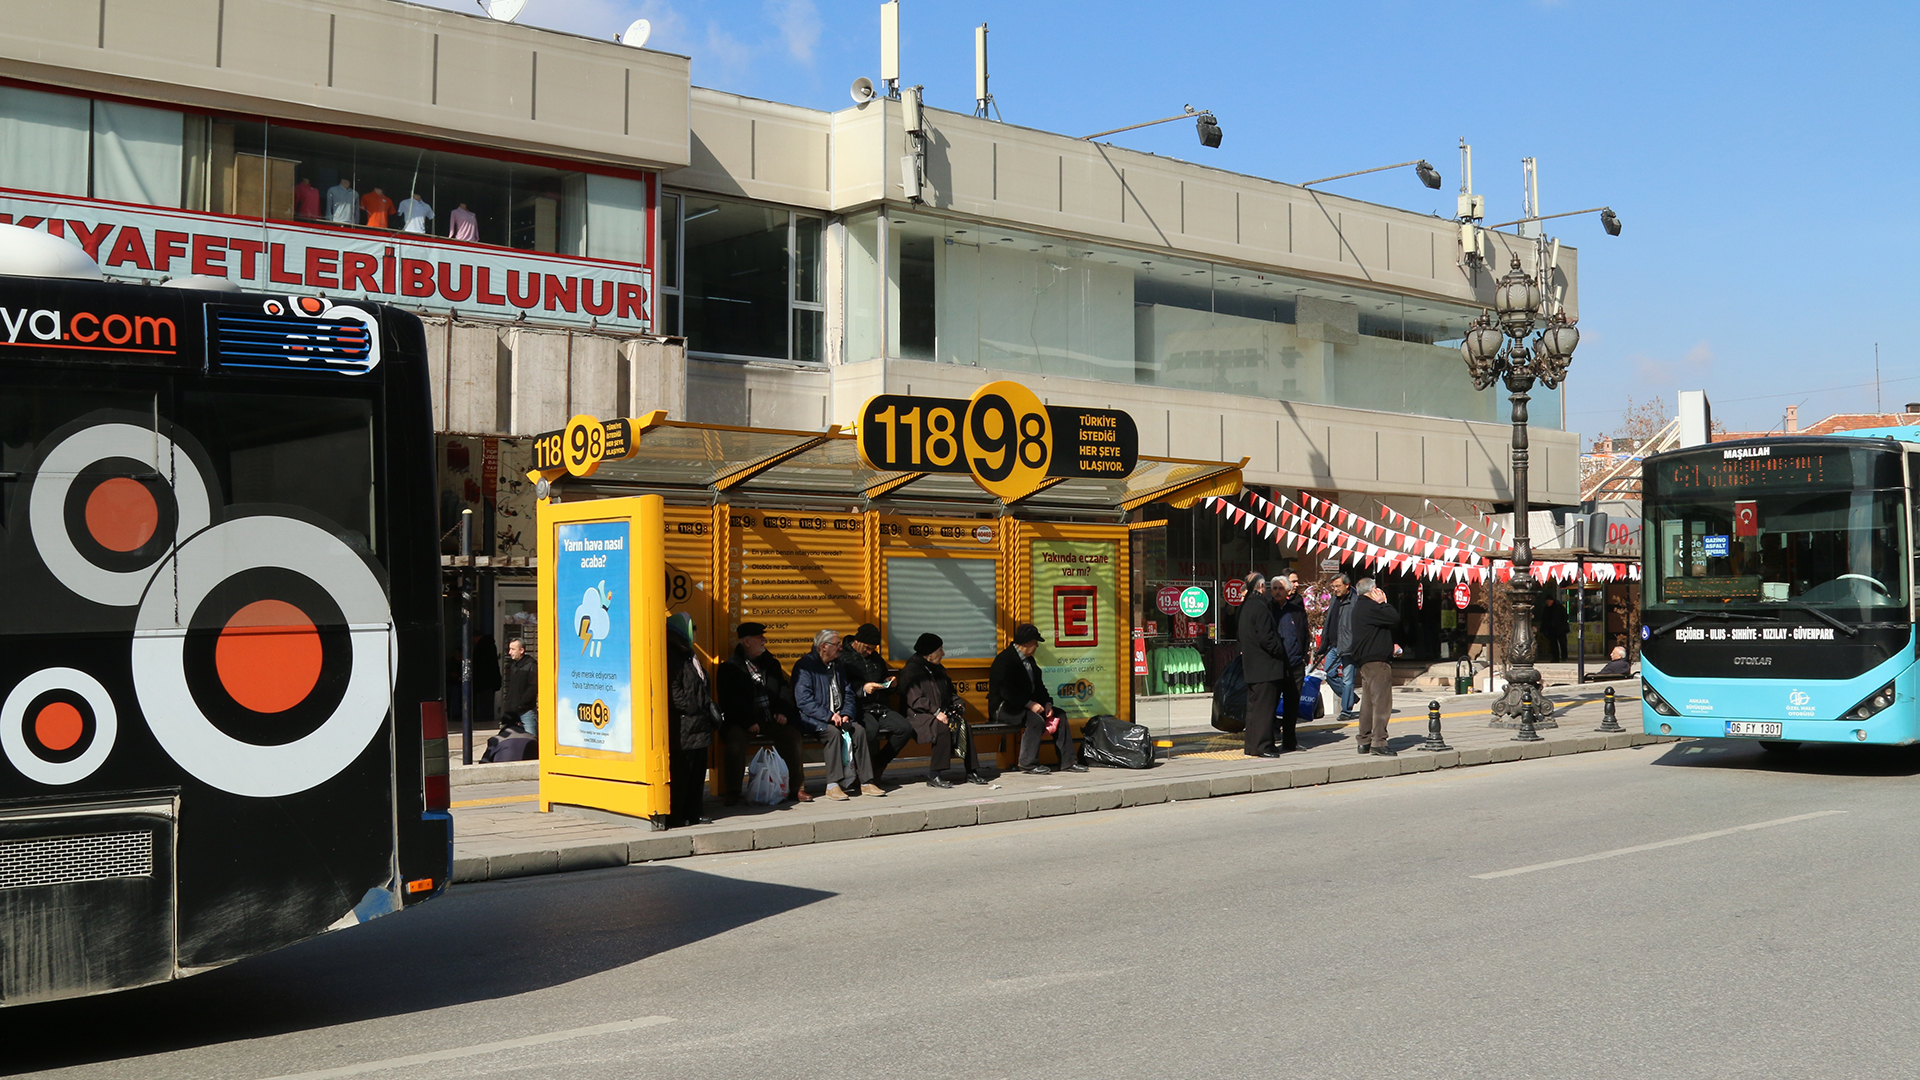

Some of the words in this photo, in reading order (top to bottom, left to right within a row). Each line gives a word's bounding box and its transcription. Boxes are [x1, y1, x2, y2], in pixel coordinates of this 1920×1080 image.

[606, 422, 622, 431] TÜRKİYE
[1079, 414, 1117, 428] TÜRKİYE
[1079, 428, 1116, 442] İSTEDİĞİ
[1079, 445, 1097, 456] HER
[1099, 446, 1121, 459] ŞEYE
[1723, 446, 1770, 460] MAŞALLAH
[1079, 460, 1125, 473] ULAŞIYOR.
[880, 523, 903, 535] 1898
[563, 539, 583, 552] Yarın
[584, 538, 603, 552] hava
[604, 536, 623, 551] nasıl
[580, 554, 607, 569] acaba?
[1042, 552, 1077, 563] Yakında
[1079, 553, 1109, 564] eczane
[1062, 568, 1075, 576] var
[1225, 587, 1242, 599] 19.9
[1183, 596, 1204, 609] 19.90
[1064, 596, 1088, 637] E
[1709, 628, 1726, 640] ULUS
[1762, 628, 1787, 640] KIZILAY
[1793, 625, 1834, 640] GÜVENPARK
[1733, 656, 1772, 665] OTOKAR
[1731, 722, 1741, 733] 06
[1746, 723, 1756, 733] FY
[1760, 724, 1780, 734] 1301
